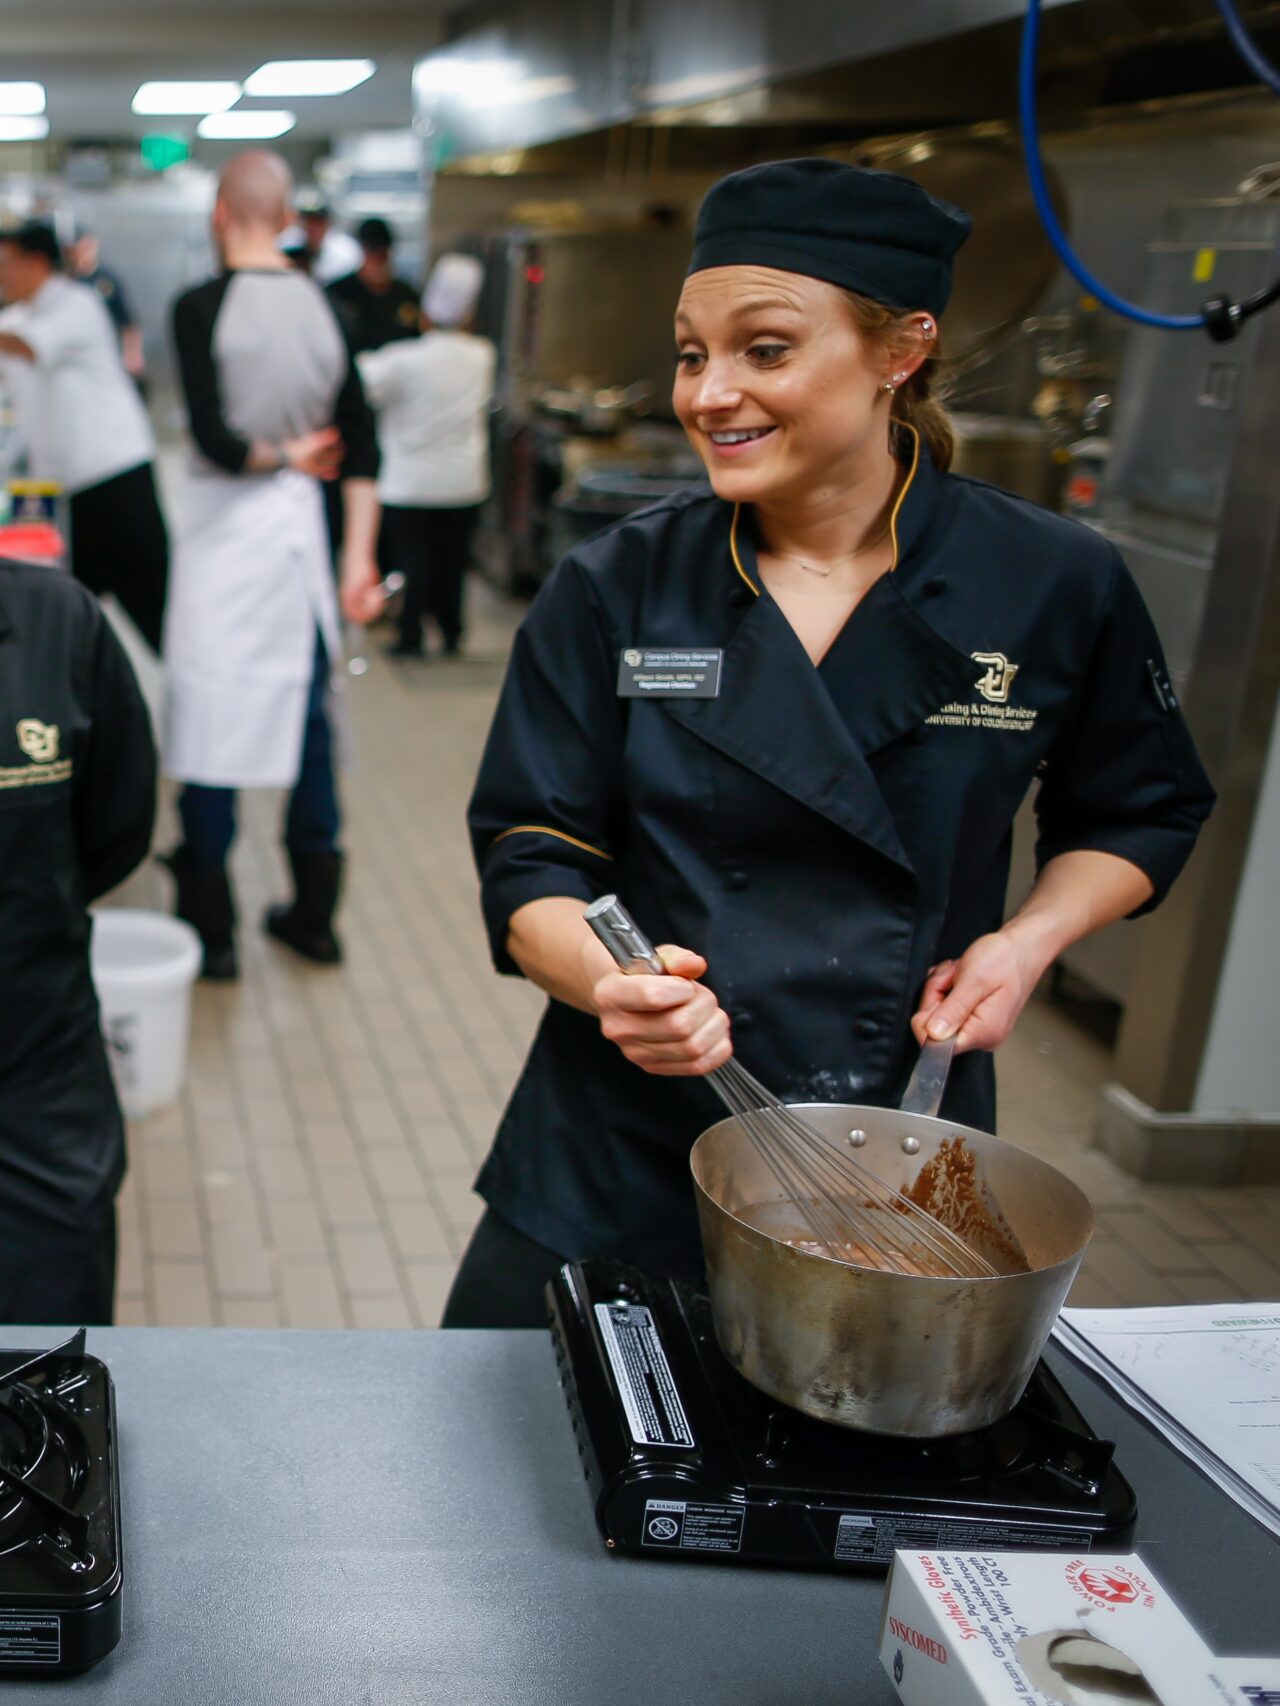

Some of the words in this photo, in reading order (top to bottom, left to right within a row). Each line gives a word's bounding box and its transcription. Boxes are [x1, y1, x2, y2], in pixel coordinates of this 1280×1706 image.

[656, 1503, 685, 1511] DANGER
[918, 1555, 946, 1589] Gloves
[936, 1555, 955, 1576] Free
[967, 1556, 994, 1588] Length
[981, 1556, 998, 1567] CT
[1065, 1559, 1086, 1573] FREE
[952, 1556, 1004, 1625] Ambidextrous
[992, 1571, 1012, 1588] 100
[1066, 1574, 1116, 1613] POWDER
[1114, 1565, 1151, 1594] POLVO
[951, 1577, 978, 1617] Powder
[989, 1589, 1014, 1617] Wrist
[1142, 1594, 1159, 1609] SIN
[937, 1591, 979, 1640] Synthetic
[889, 1616, 948, 1665] SYSCOMED
[980, 1625, 1006, 1658] Grade
[1003, 1661, 1028, 1693] Exam
